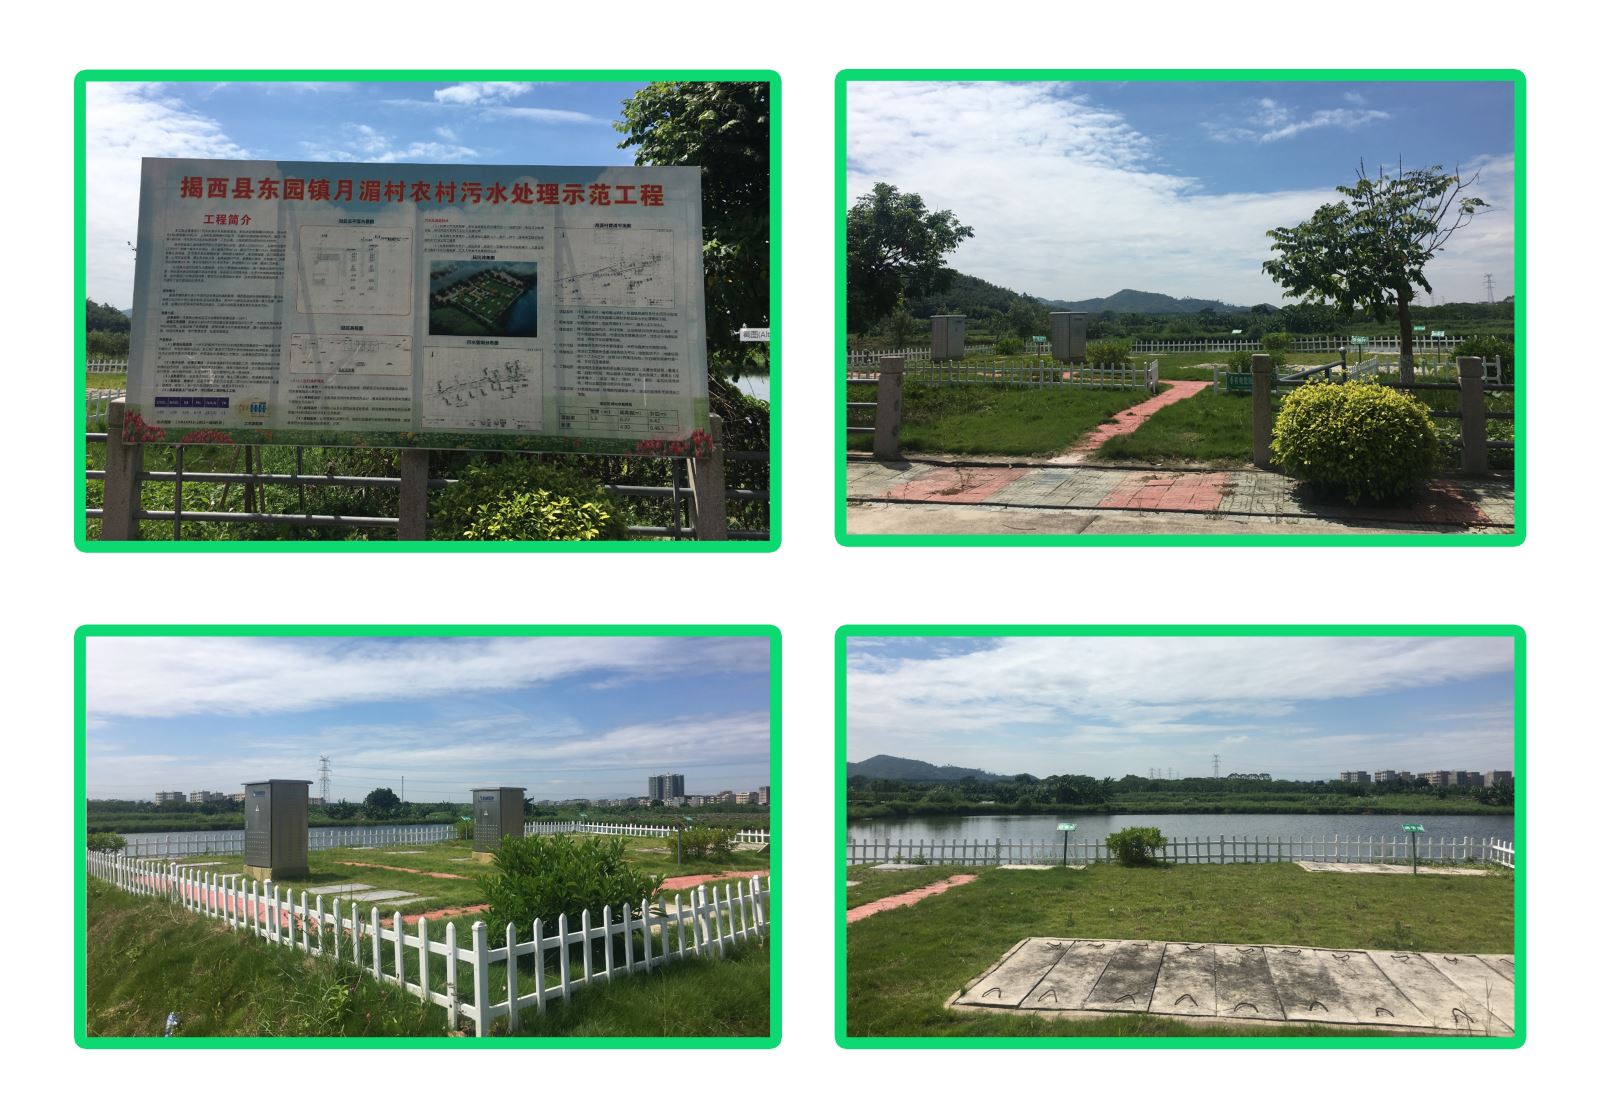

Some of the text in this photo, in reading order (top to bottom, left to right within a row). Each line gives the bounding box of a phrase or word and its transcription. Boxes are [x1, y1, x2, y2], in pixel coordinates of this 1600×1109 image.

[180, 175, 665, 207] 揭西县东园镇月湄村农村污水处理示范工程
[203, 213, 252, 226] 工程简介
